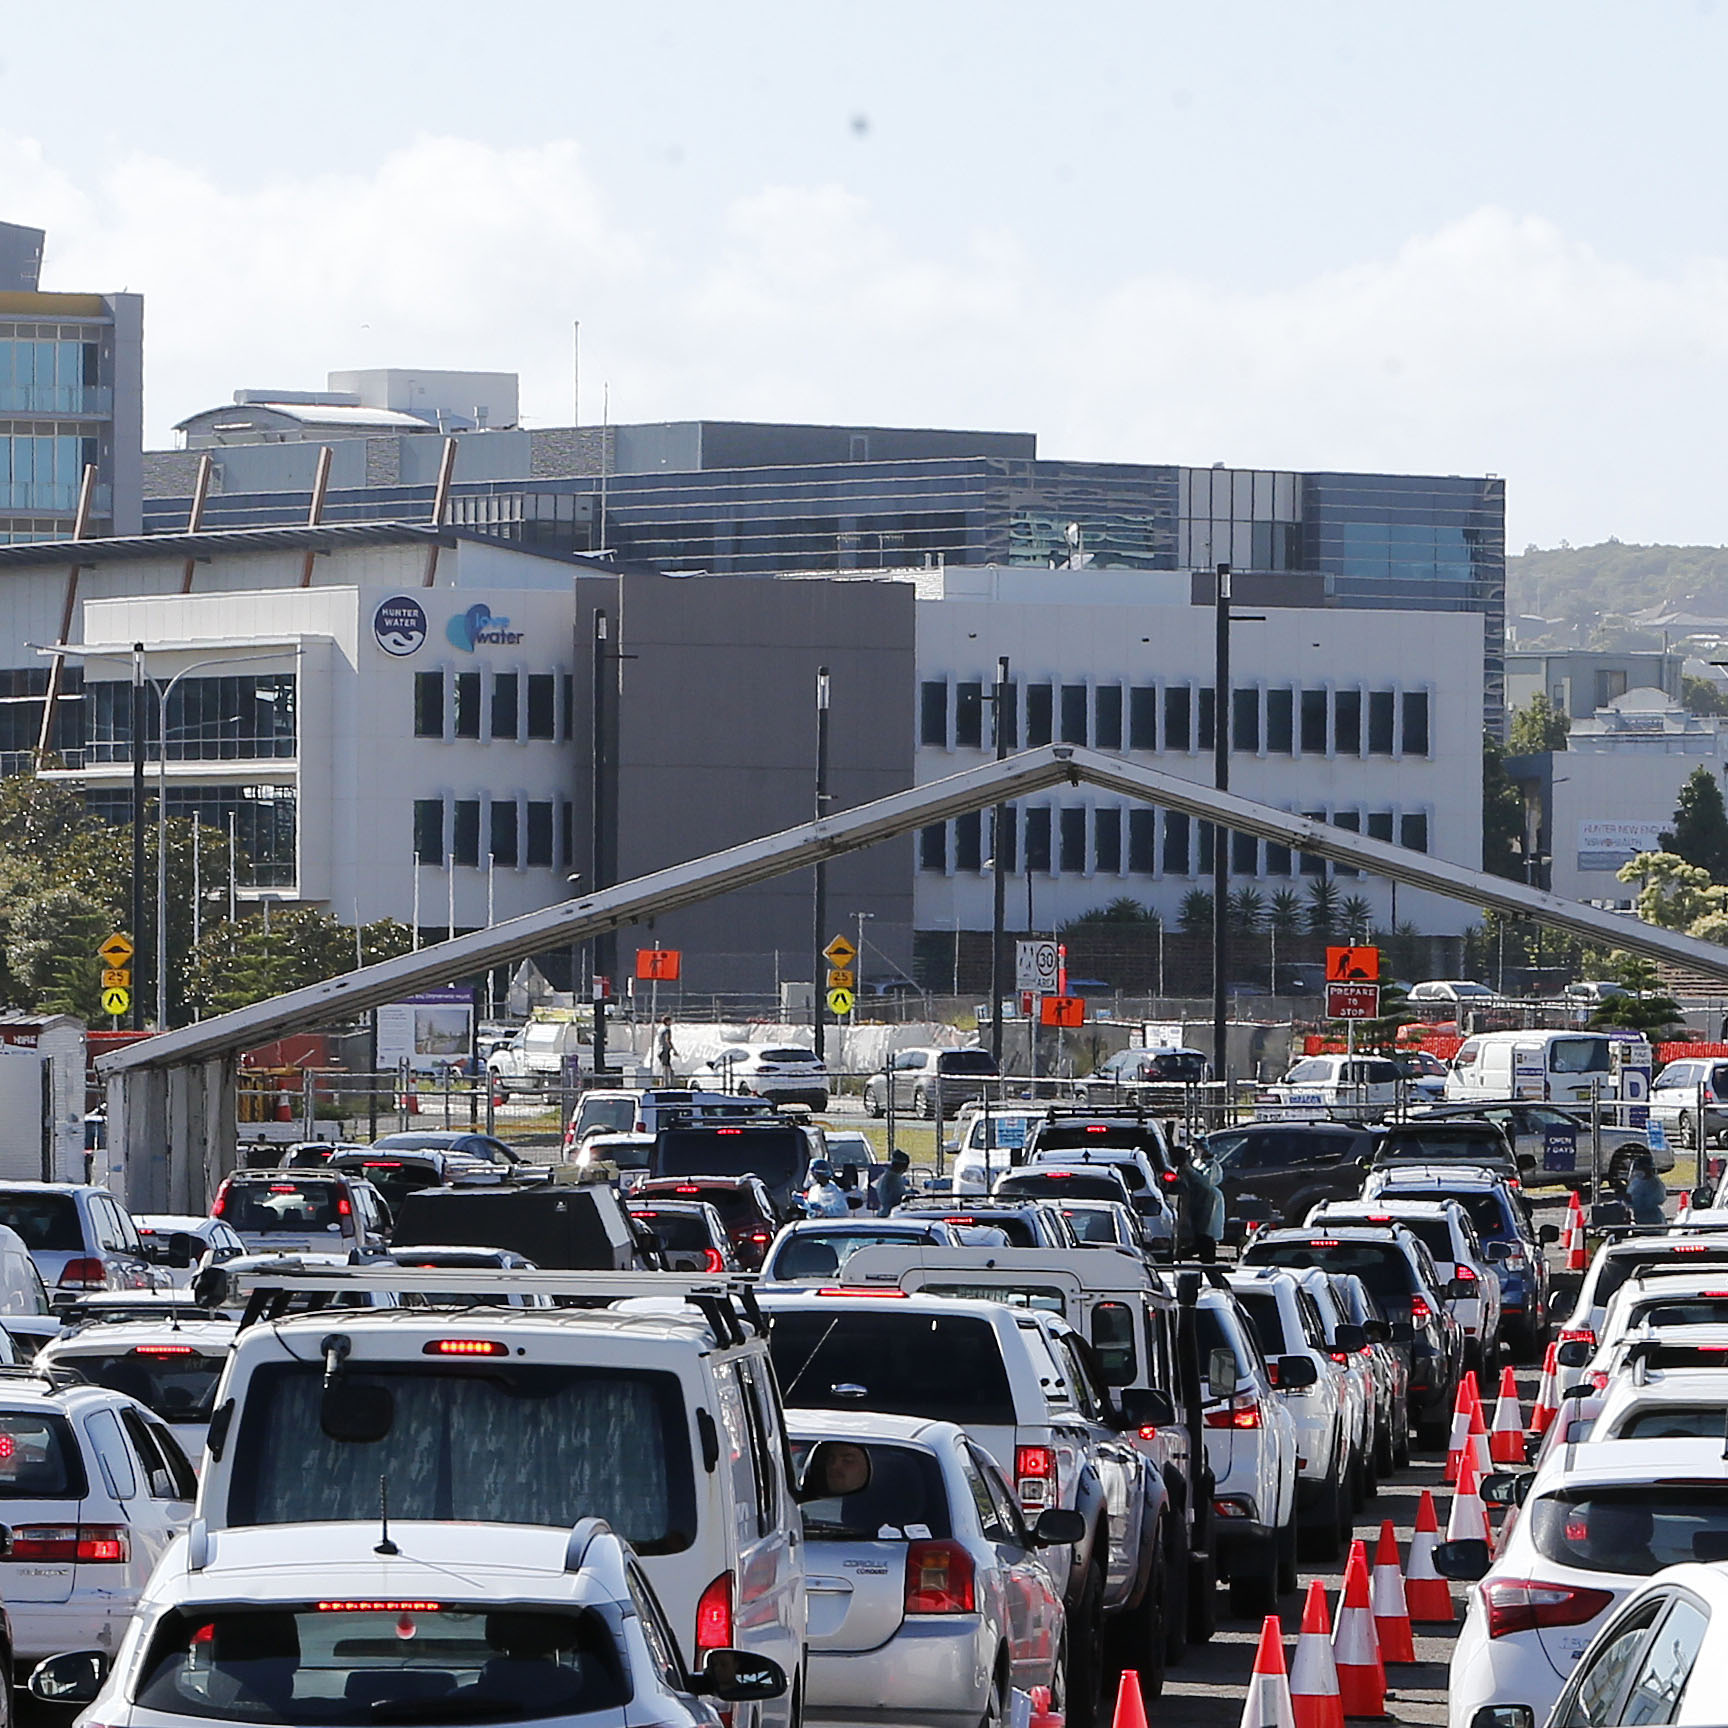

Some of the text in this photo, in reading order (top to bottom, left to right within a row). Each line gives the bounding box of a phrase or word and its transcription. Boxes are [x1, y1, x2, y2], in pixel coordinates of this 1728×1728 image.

[382, 609, 419, 617] HUNTER
[383, 618, 418, 627] WATER
[477, 630, 524, 645] water
[1039, 953, 1053, 968] 30
[107, 972, 123, 985] 25
[833, 972, 849, 984] 25
[1330, 988, 1376, 997] PREPARE
[1348, 998, 1358, 1006] TO
[1340, 1008, 1365, 1017] STOP
[13, 1036, 37, 1046] HIRE
[1549, 1136, 1572, 1145] OPEN
